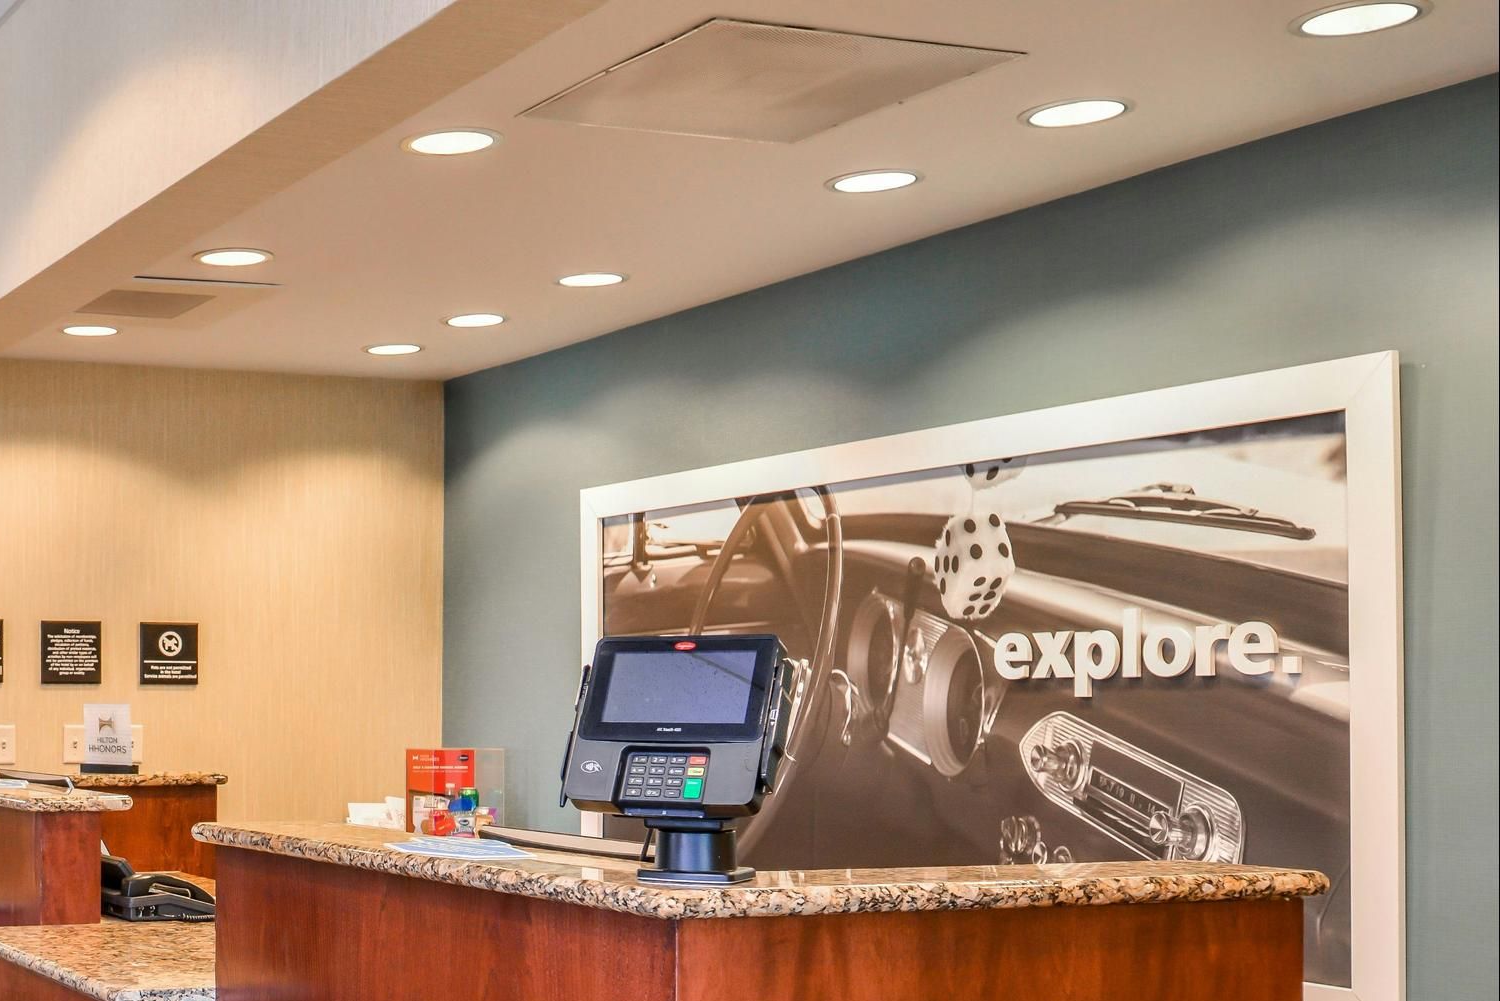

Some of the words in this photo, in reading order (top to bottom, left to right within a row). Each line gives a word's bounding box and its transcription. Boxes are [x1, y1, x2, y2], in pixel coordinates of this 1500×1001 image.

[994, 607, 1303, 698] explore.
[96, 736, 118, 744] HILTON
[88, 744, 127, 754] HHONORS
